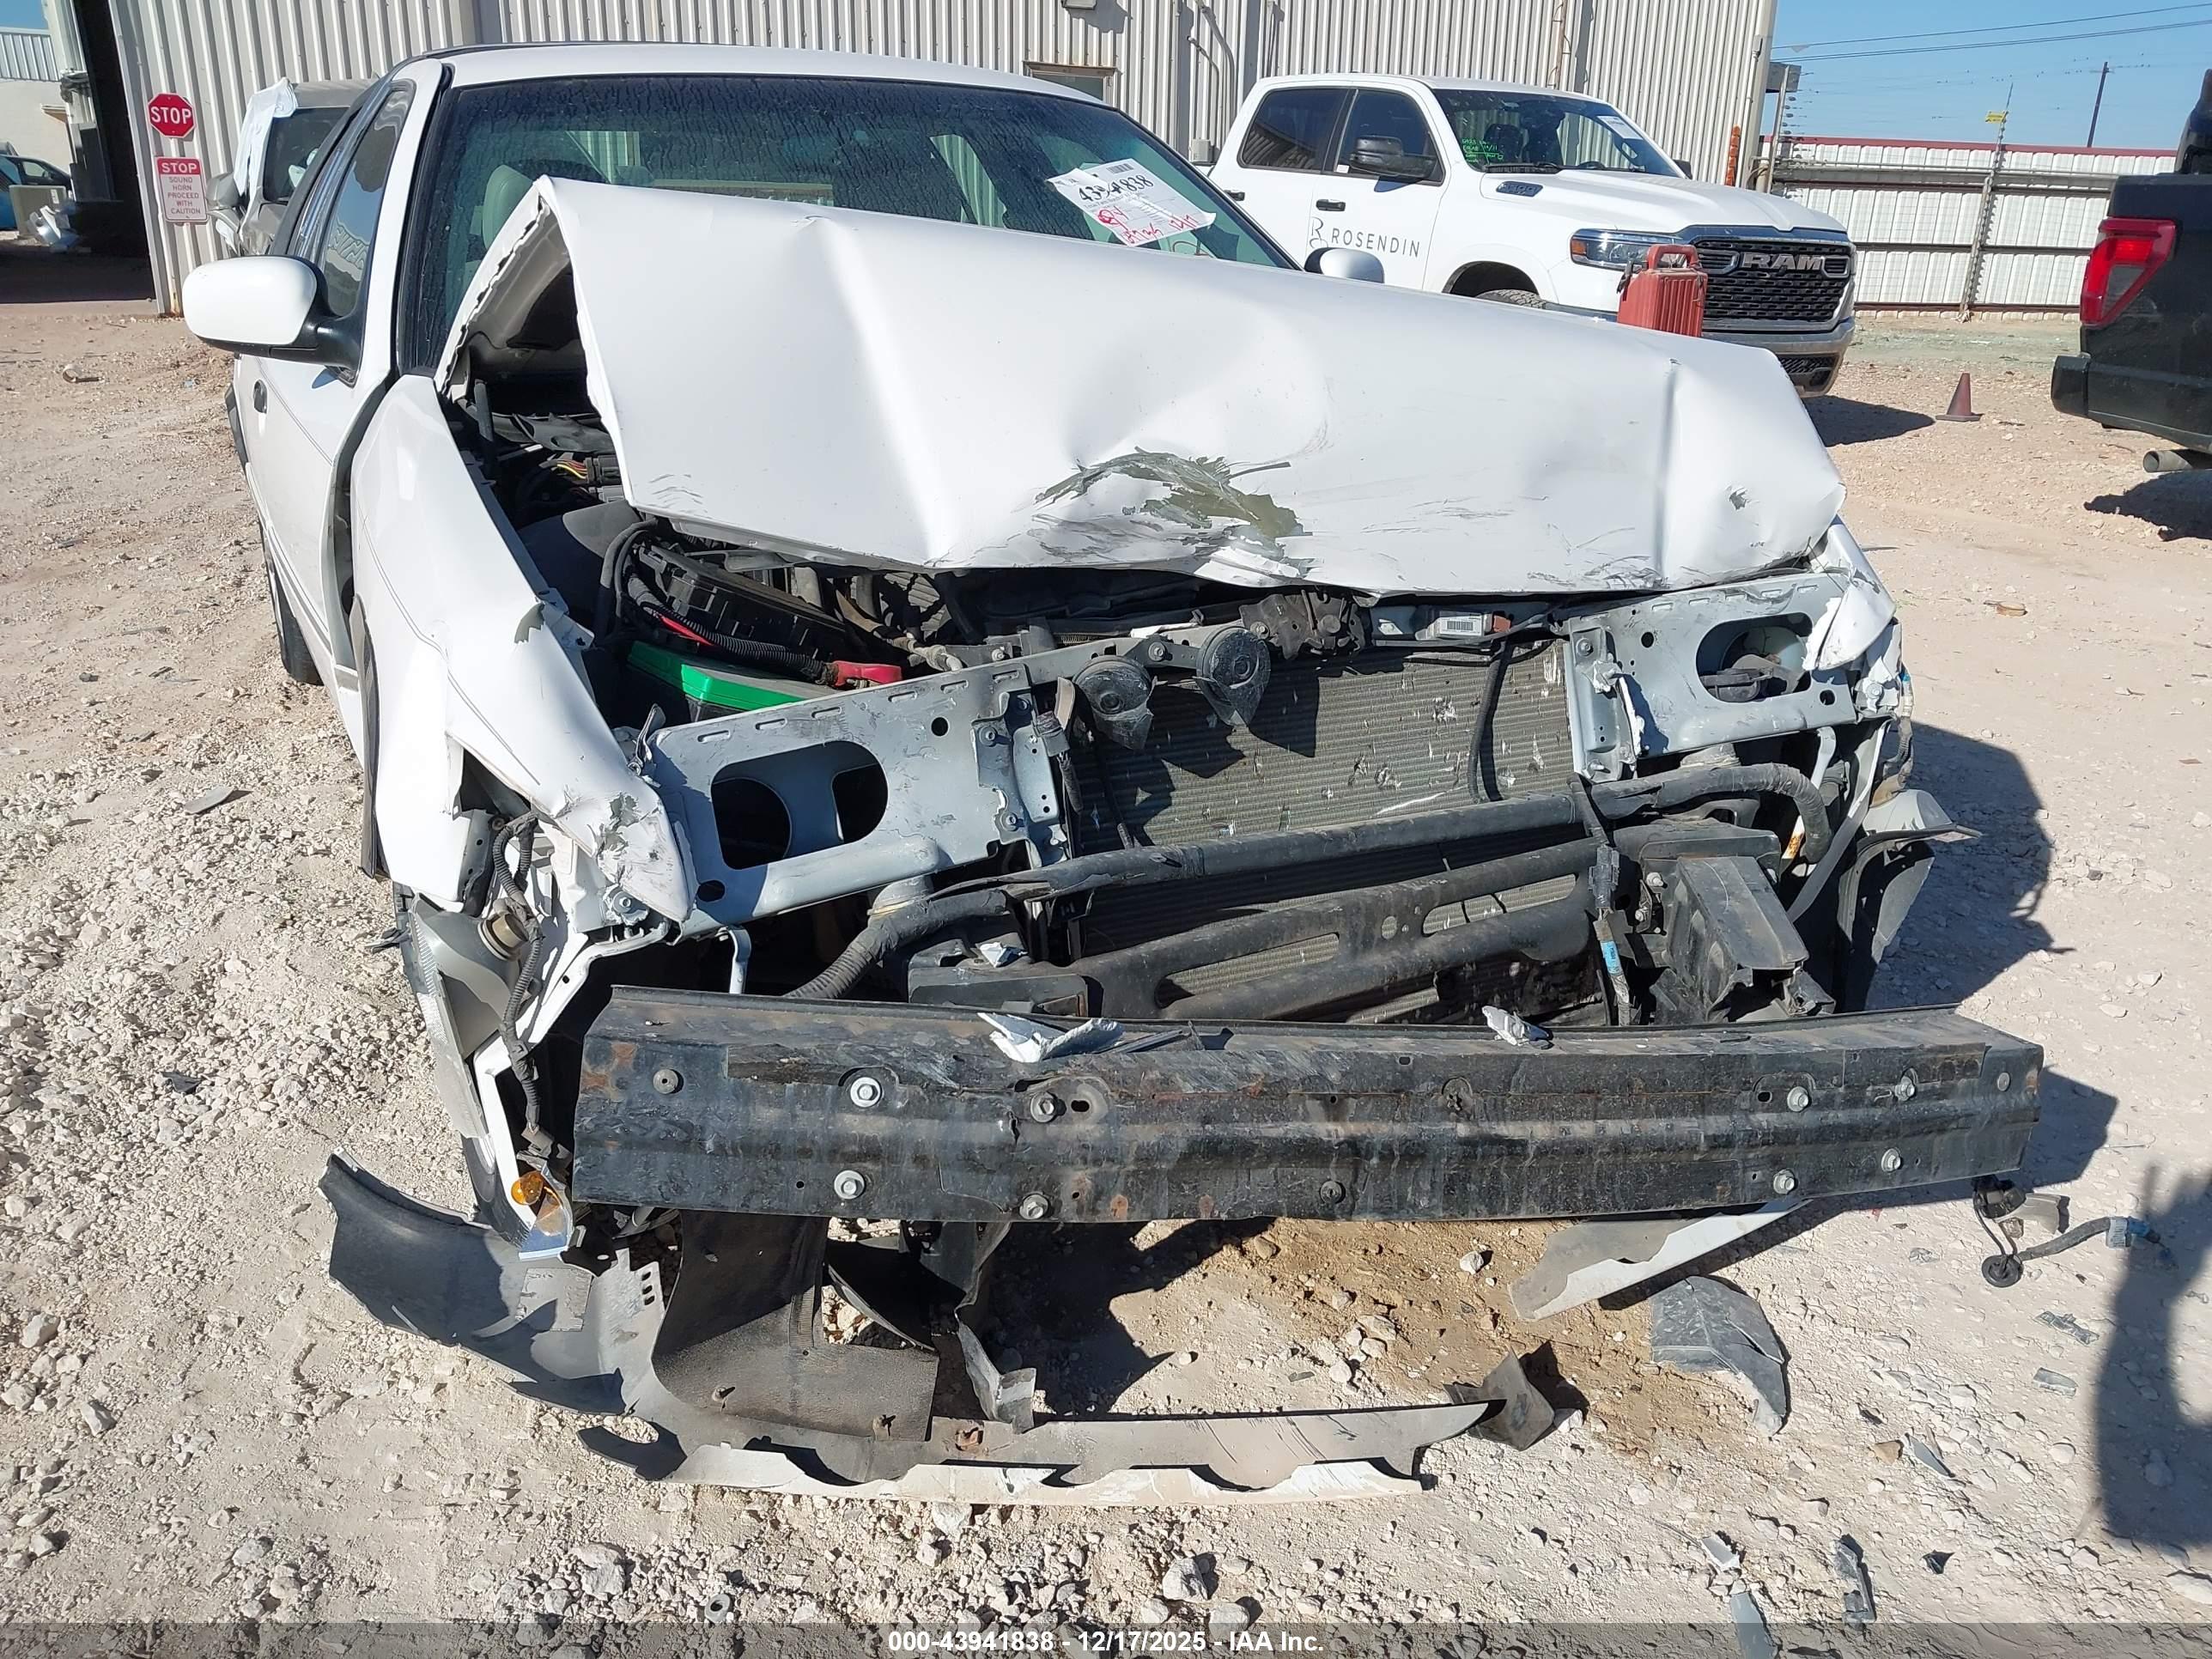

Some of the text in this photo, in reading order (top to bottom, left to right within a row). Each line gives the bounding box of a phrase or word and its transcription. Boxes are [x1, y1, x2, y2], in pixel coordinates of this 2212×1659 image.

[150, 106, 191, 124] STOP
[161, 162, 198, 173] STOP
[1331, 228, 1420, 258] ROSENDIN
[1741, 252, 1821, 270] RAM
